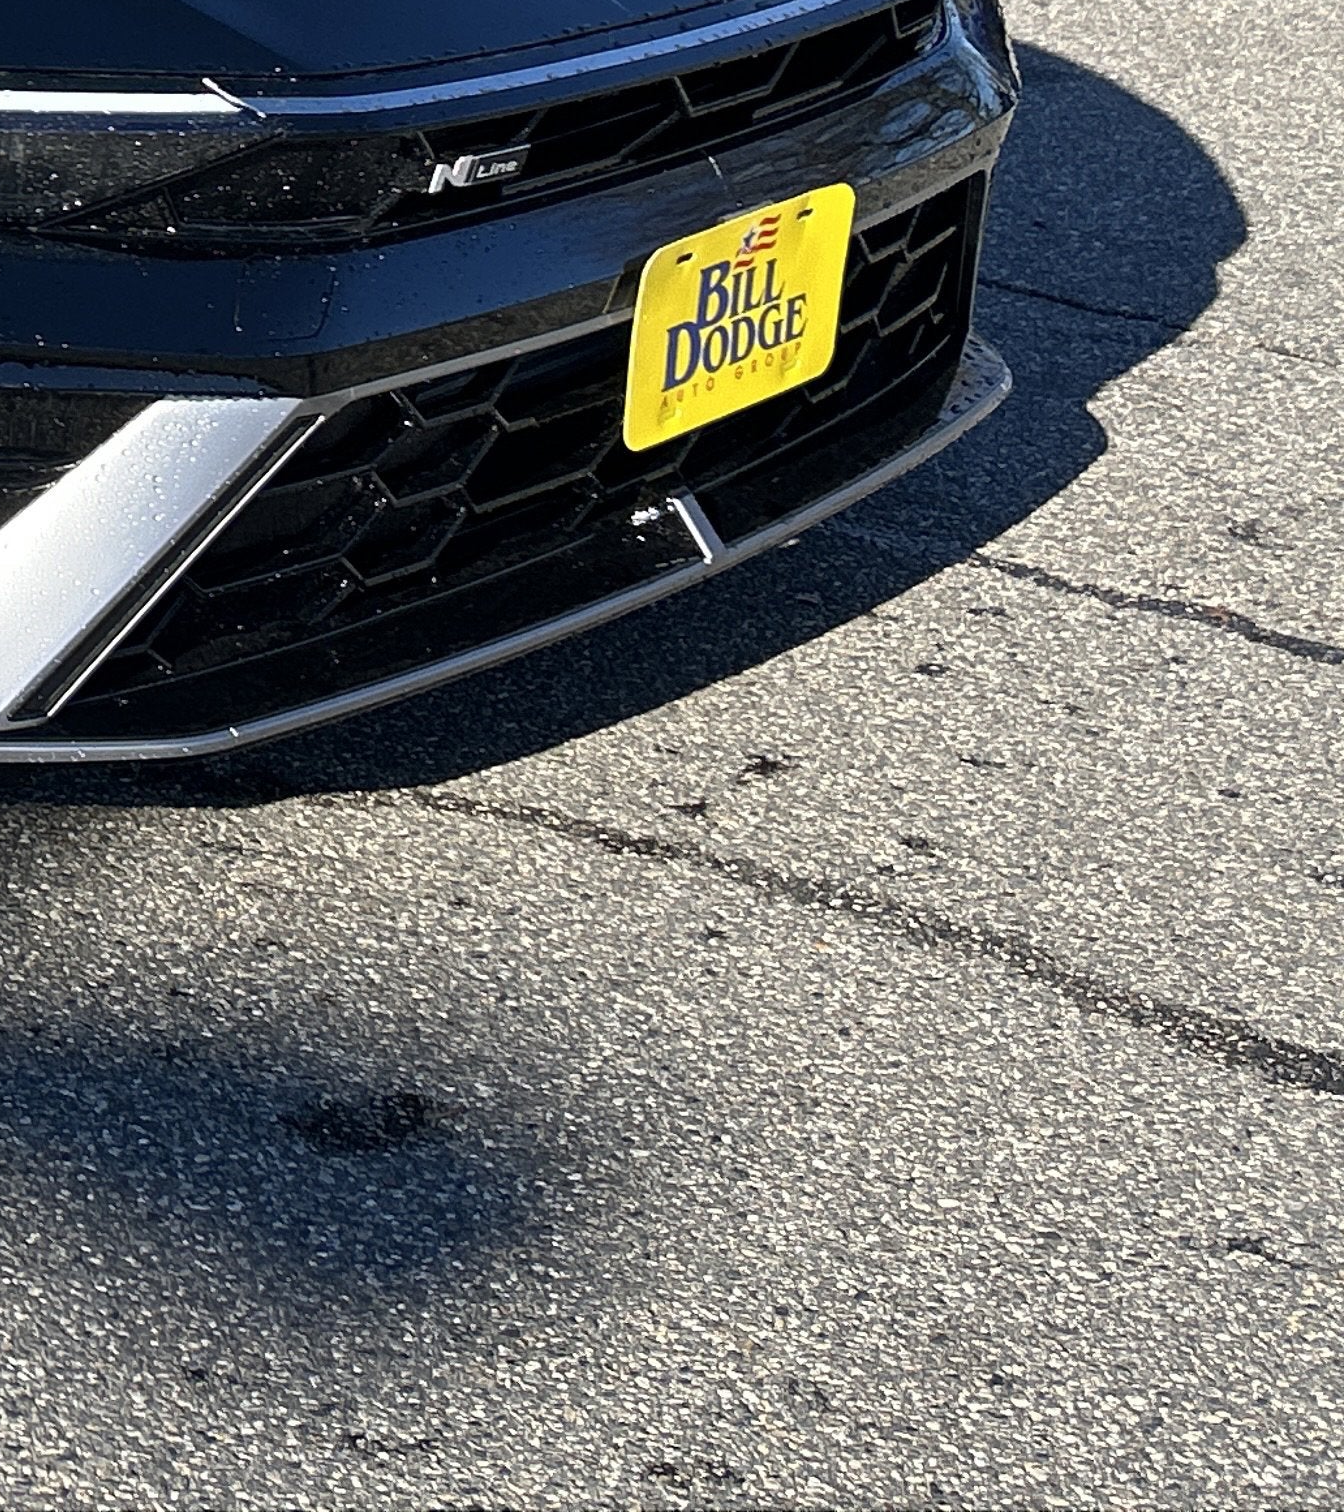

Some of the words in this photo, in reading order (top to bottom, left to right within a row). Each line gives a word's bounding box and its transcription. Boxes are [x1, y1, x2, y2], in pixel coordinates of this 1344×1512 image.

[696, 257, 786, 329] BILL
[660, 292, 808, 393] DODGE
[660, 376, 715, 410] AUTO
[734, 341, 802, 380] GROUP
